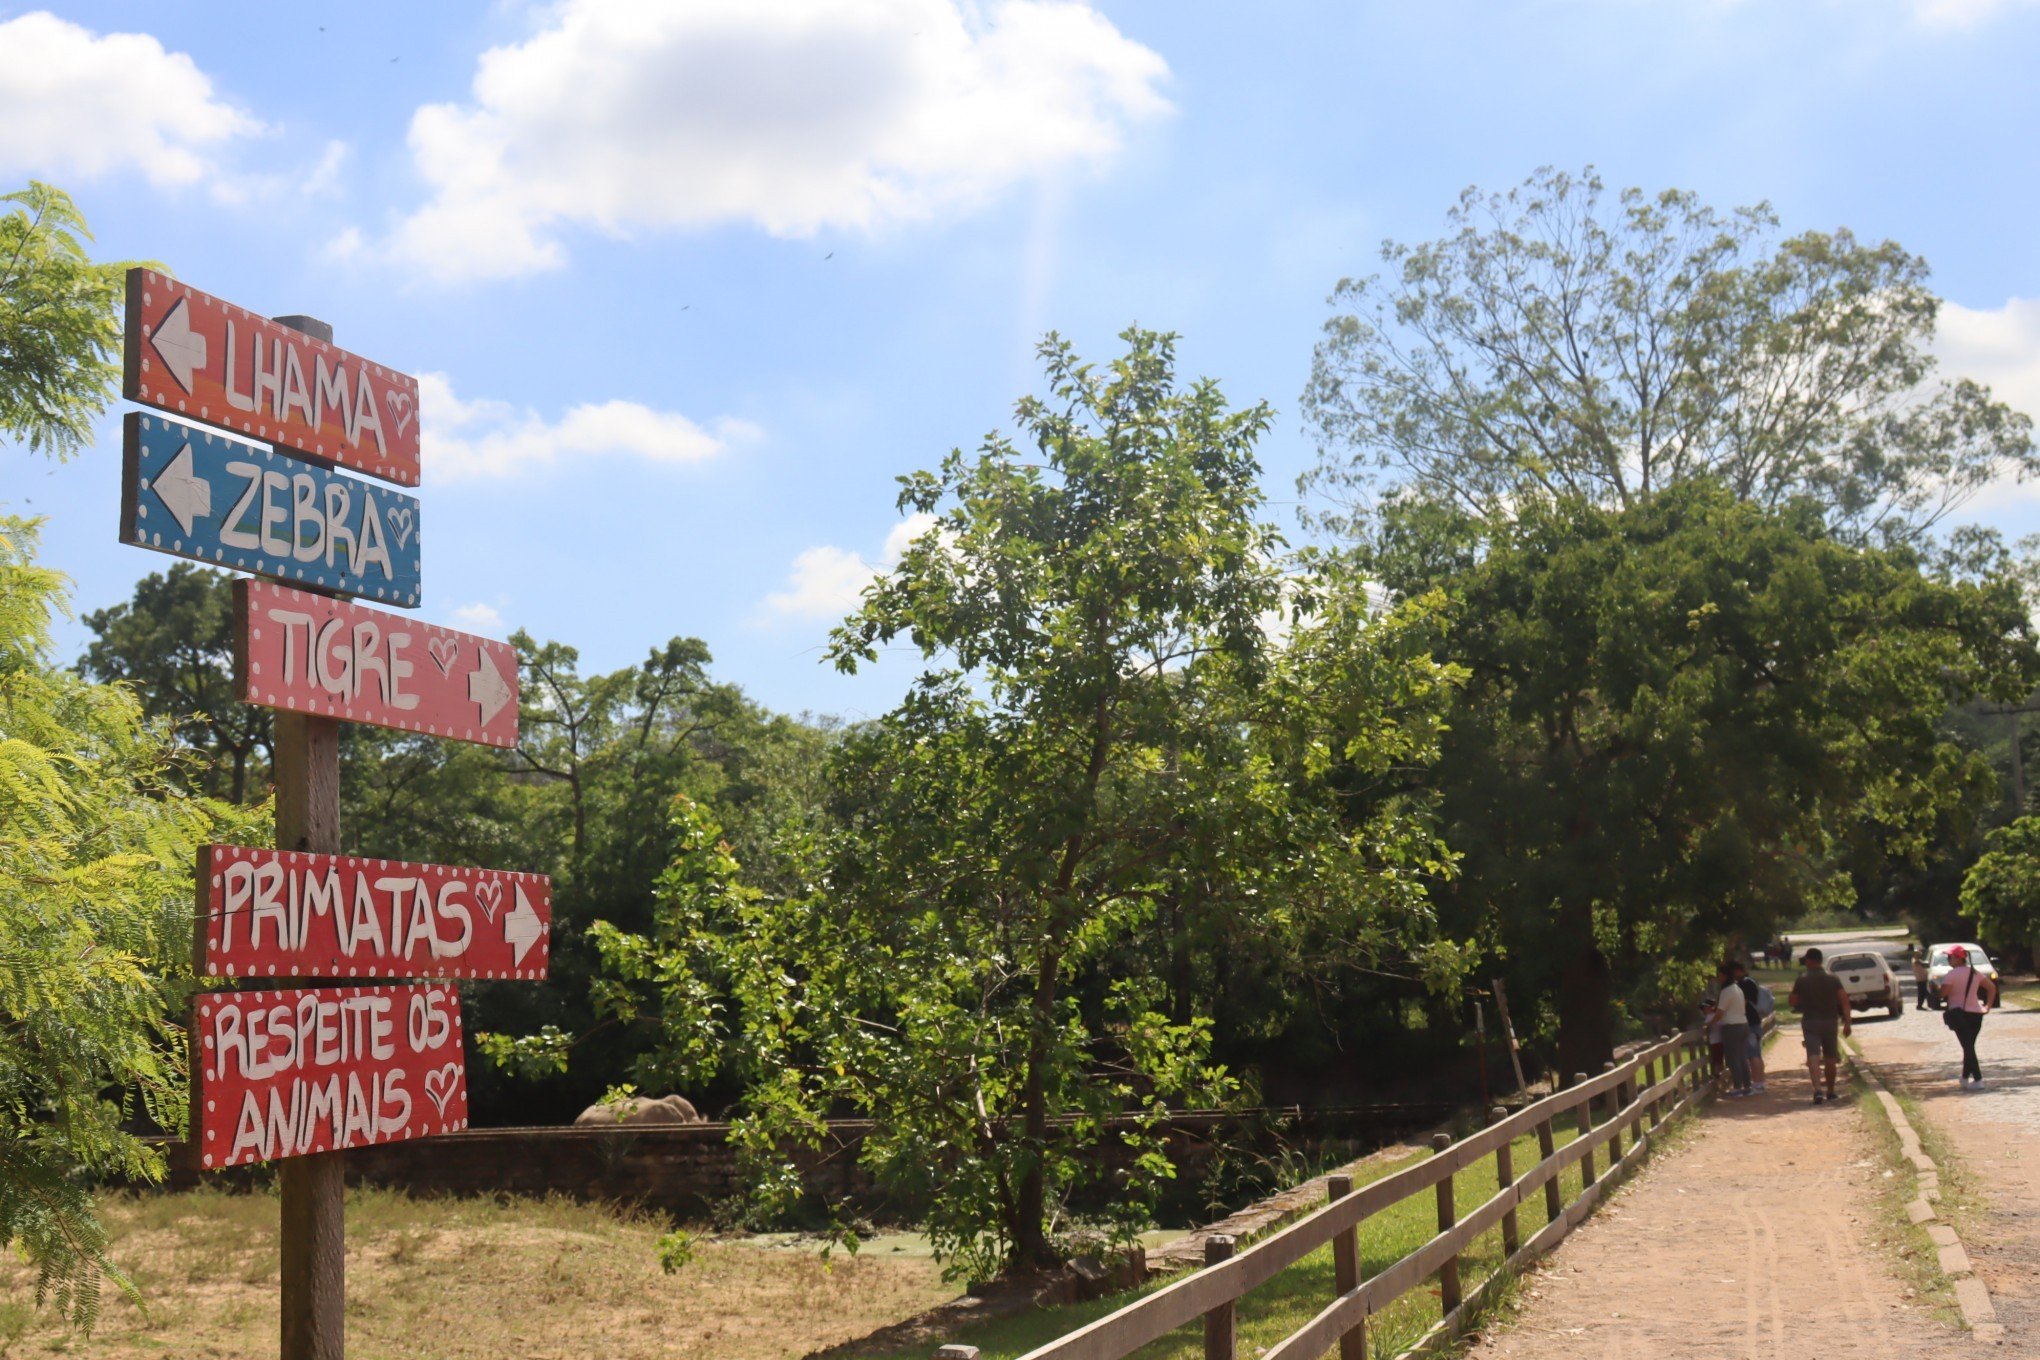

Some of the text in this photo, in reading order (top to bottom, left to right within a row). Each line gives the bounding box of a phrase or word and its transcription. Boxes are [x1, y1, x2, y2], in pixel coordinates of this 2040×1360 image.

[225, 320, 387, 458] LHAMA
[220, 461, 393, 581] ZEBRA
[268, 608, 420, 711] TIGRE
[222, 860, 473, 961] PRIMATAS
[215, 990, 451, 1081] RESPEITE OS
[225, 1068, 412, 1166] ANIMAIS
